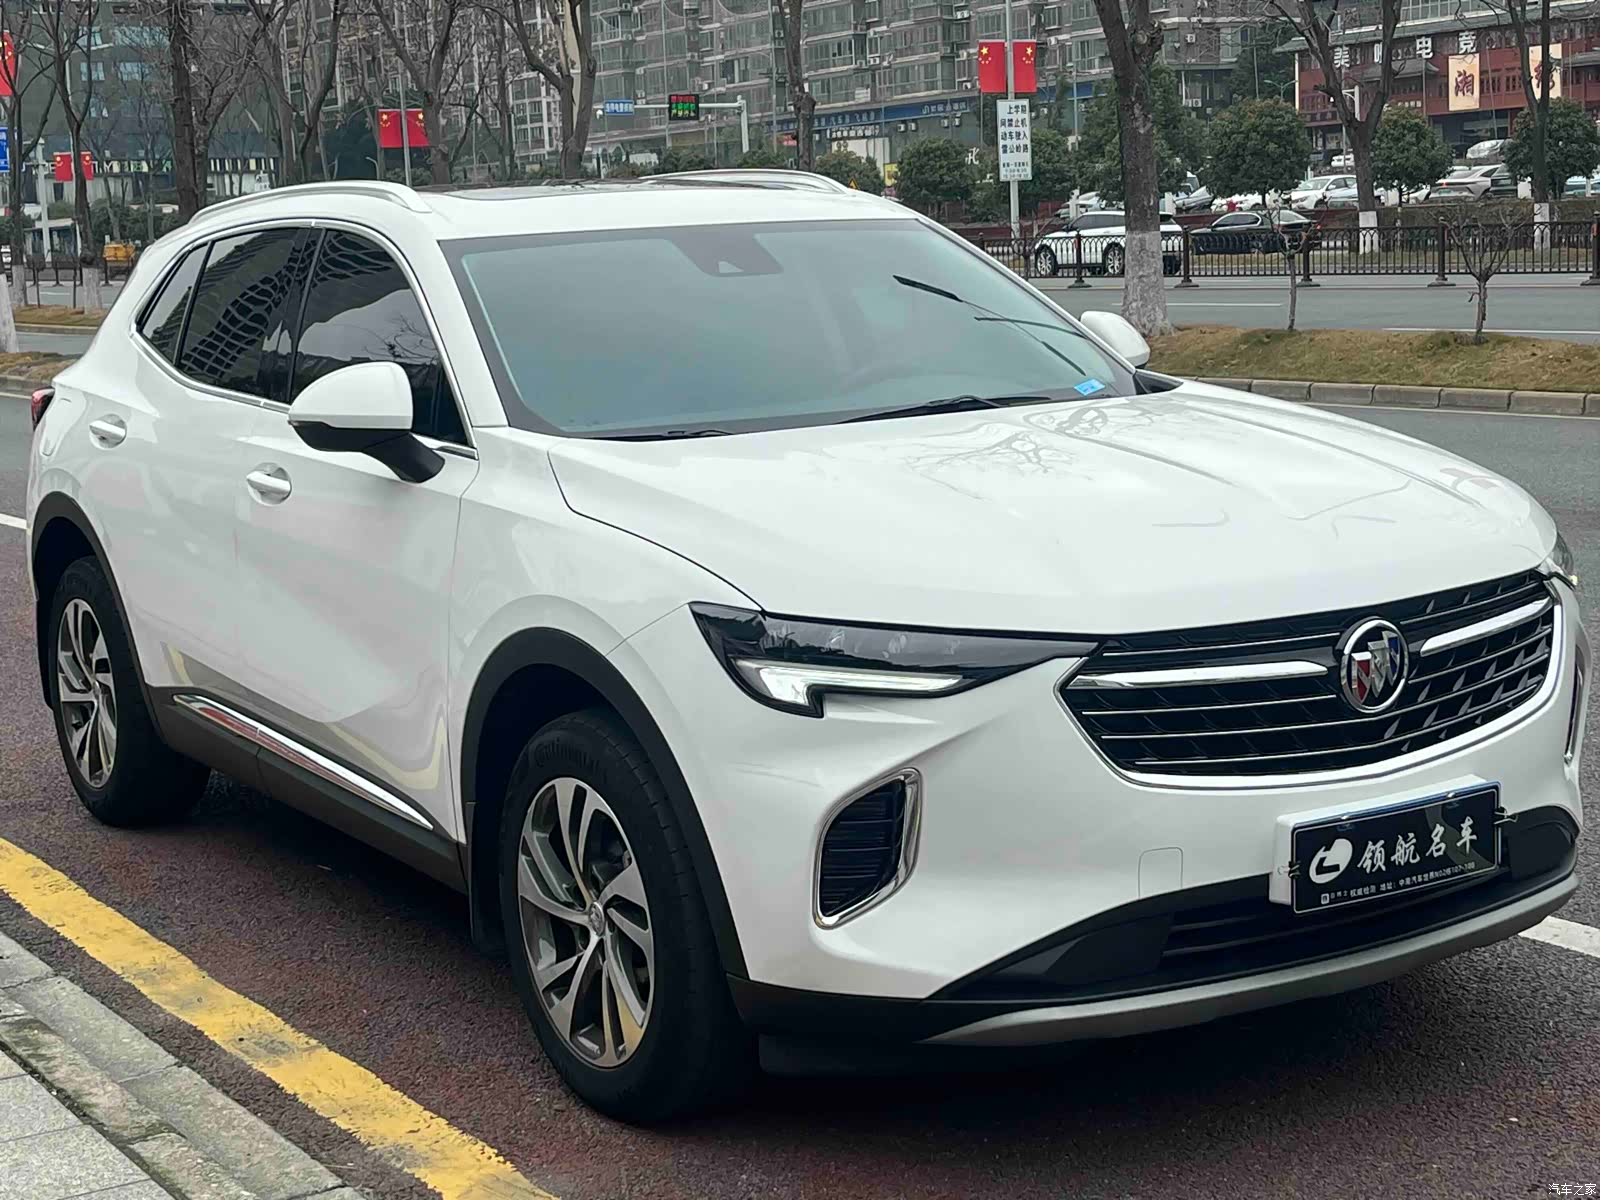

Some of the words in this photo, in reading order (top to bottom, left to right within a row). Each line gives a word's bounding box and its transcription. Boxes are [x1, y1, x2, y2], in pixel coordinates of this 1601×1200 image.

[1454, 69, 1475, 97] 湘
[1357, 815, 1478, 874] 领航名车
